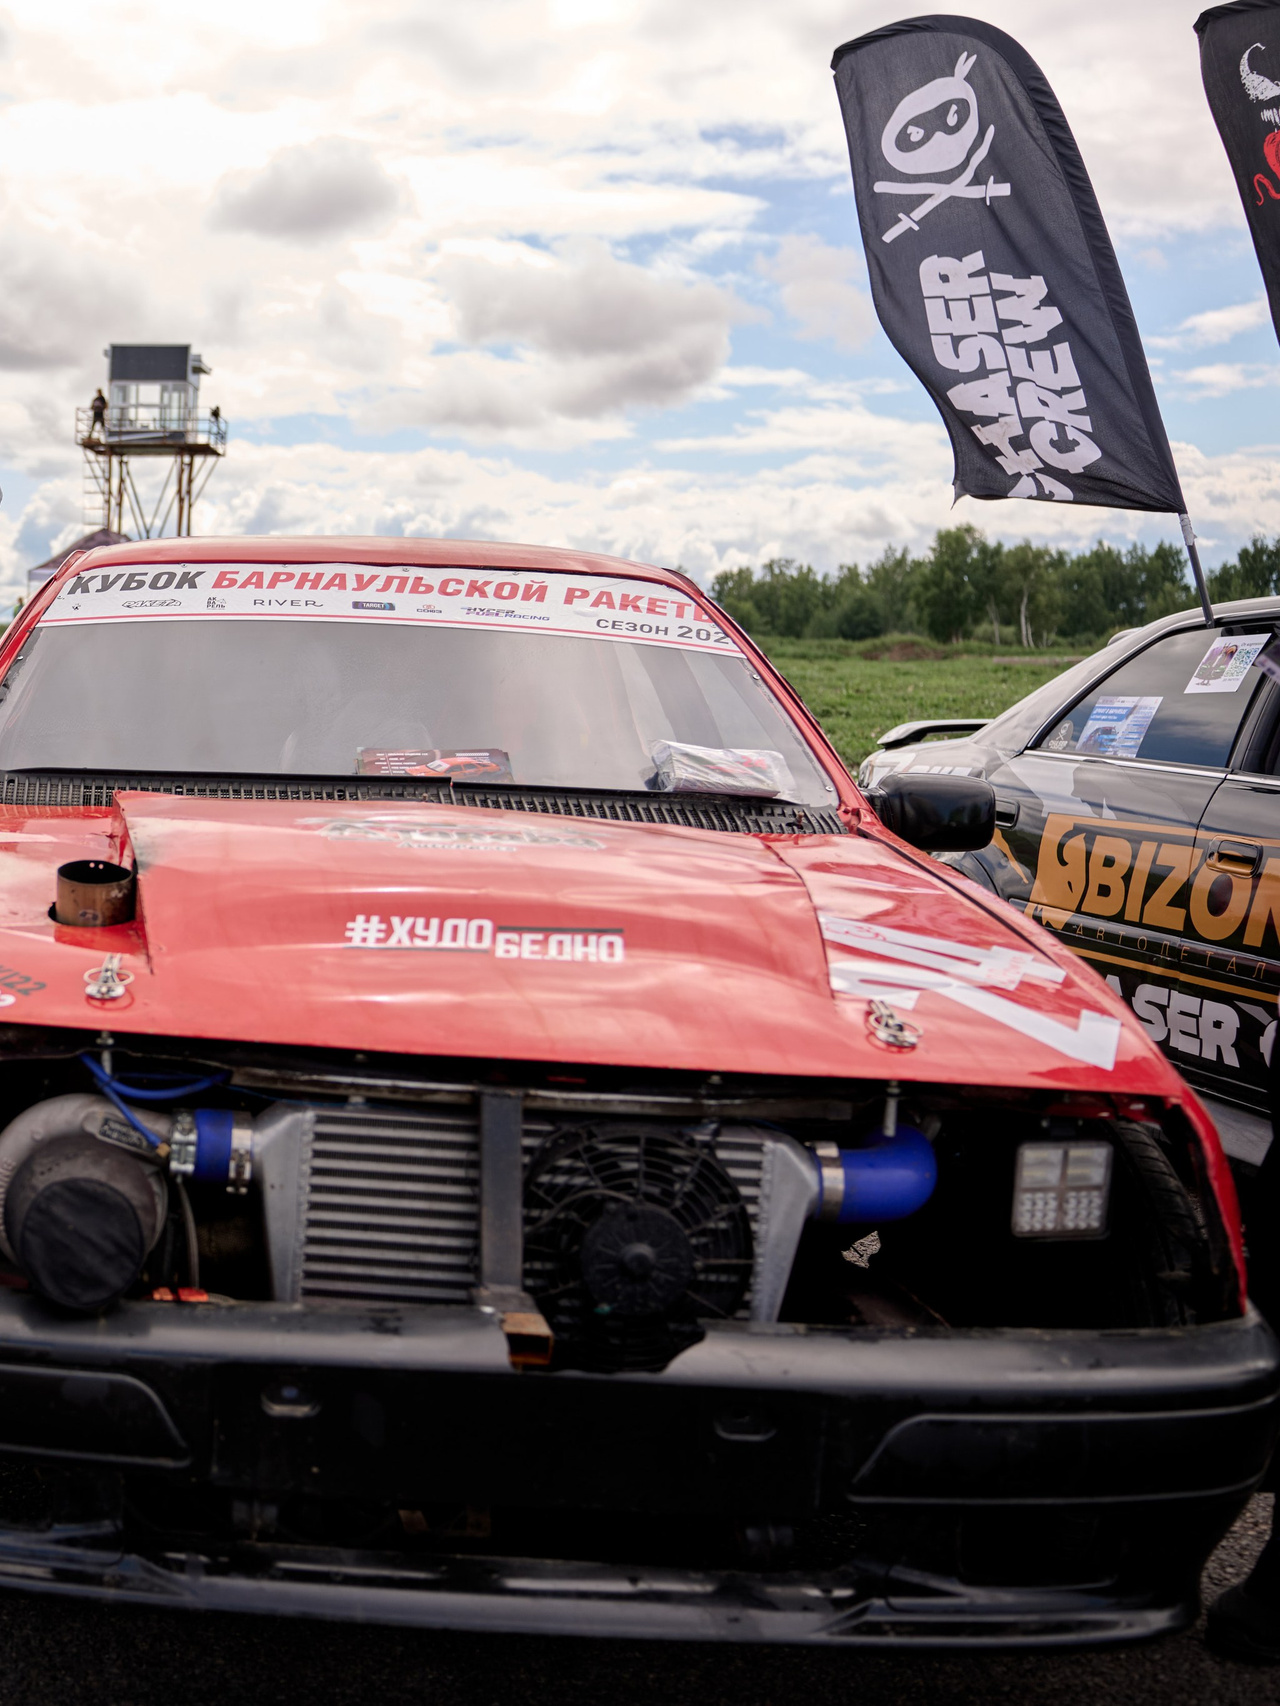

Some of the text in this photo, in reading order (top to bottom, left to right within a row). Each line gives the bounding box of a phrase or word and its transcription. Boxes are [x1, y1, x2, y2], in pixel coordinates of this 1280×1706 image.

[989, 272, 1102, 474] CREW
[67, 571, 206, 595] КУБОК
[211, 571, 549, 603] БАРНАУЛЬСКОЙ
[253, 599, 324, 607] RIVER
[596, 618, 669, 636] СЕЗОН
[345, 915, 625, 963] #ХУДО БЕДНО
[1106, 974, 1240, 1068] SER
